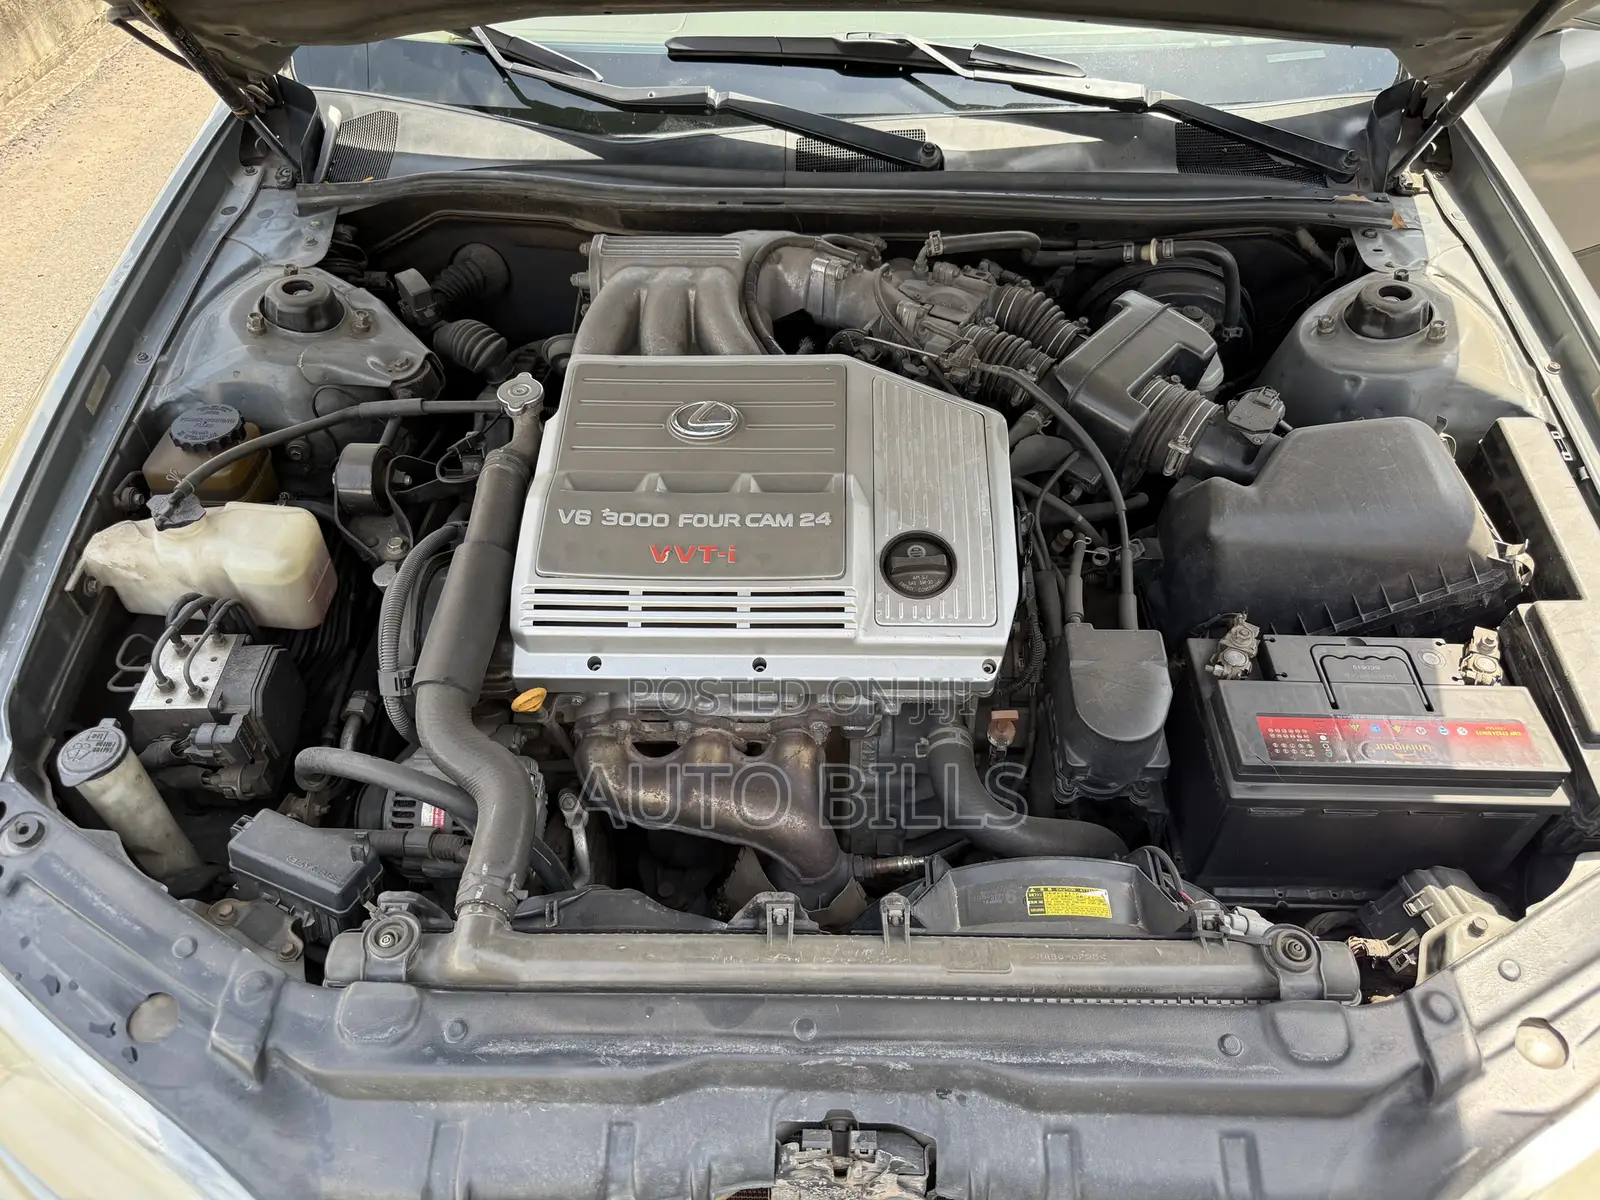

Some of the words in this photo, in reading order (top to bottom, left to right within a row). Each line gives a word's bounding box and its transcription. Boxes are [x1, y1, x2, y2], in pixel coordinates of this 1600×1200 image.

[558, 509, 592, 526] V6
[601, 508, 670, 527] 3000
[678, 513, 741, 528] FOUR
[745, 512, 794, 528] CAM
[799, 512, 832, 527] 24
[650, 545, 737, 564] VVT-i
[1375, 742, 1433, 753] Univigour
